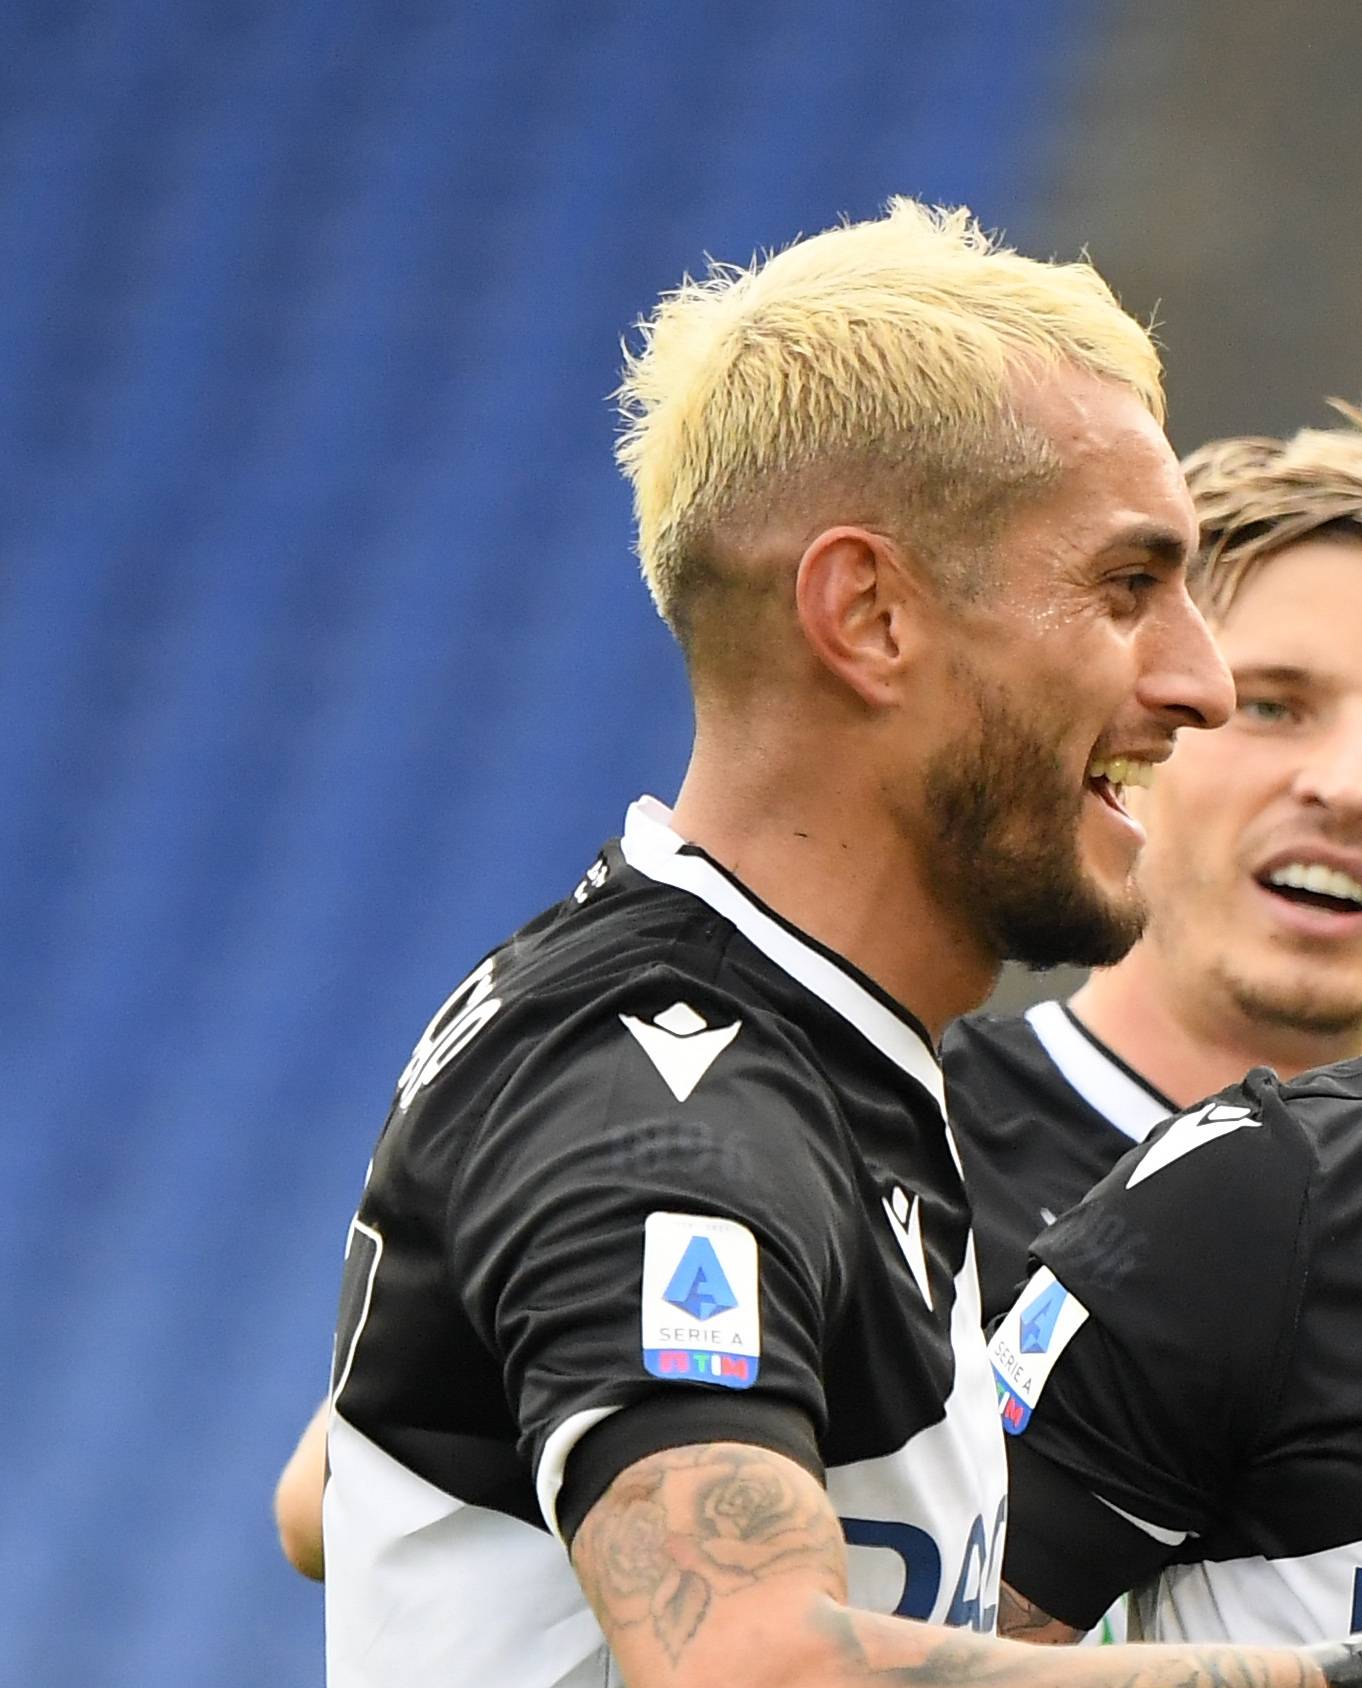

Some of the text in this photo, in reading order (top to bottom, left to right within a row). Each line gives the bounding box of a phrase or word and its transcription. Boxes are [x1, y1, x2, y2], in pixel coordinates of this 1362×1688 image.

[659, 1327, 744, 1345] SERIE A
[994, 1340, 1032, 1395] SERIE A
